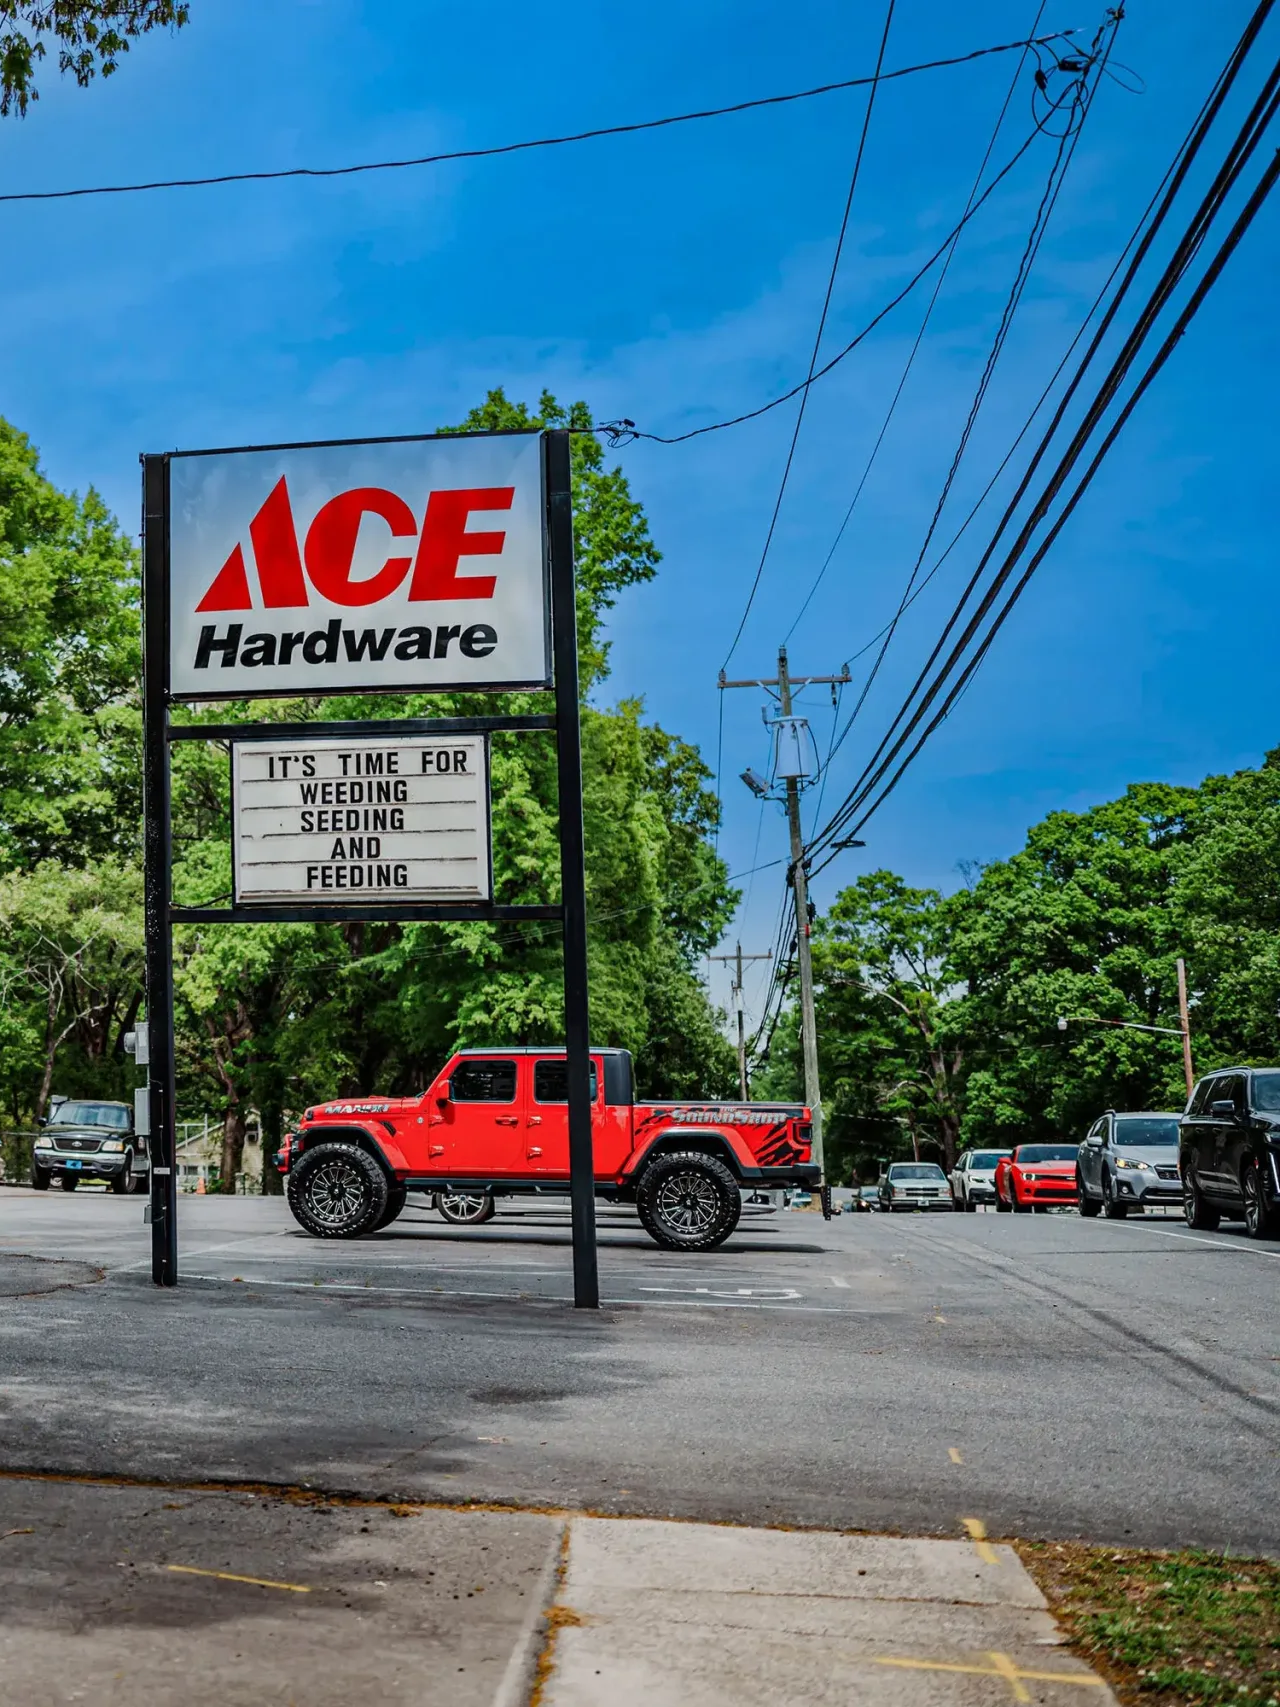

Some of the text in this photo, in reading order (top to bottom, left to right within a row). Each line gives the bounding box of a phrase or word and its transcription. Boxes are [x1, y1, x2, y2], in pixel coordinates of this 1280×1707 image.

[194, 474, 516, 613] ACE
[194, 618, 498, 669] Hardware
[268, 749, 468, 779] IT'S TIME FOR
[299, 779, 408, 806] WEEDING
[300, 808, 404, 833] SEEDING
[330, 836, 381, 860] AND
[306, 864, 408, 889] FEEDING
